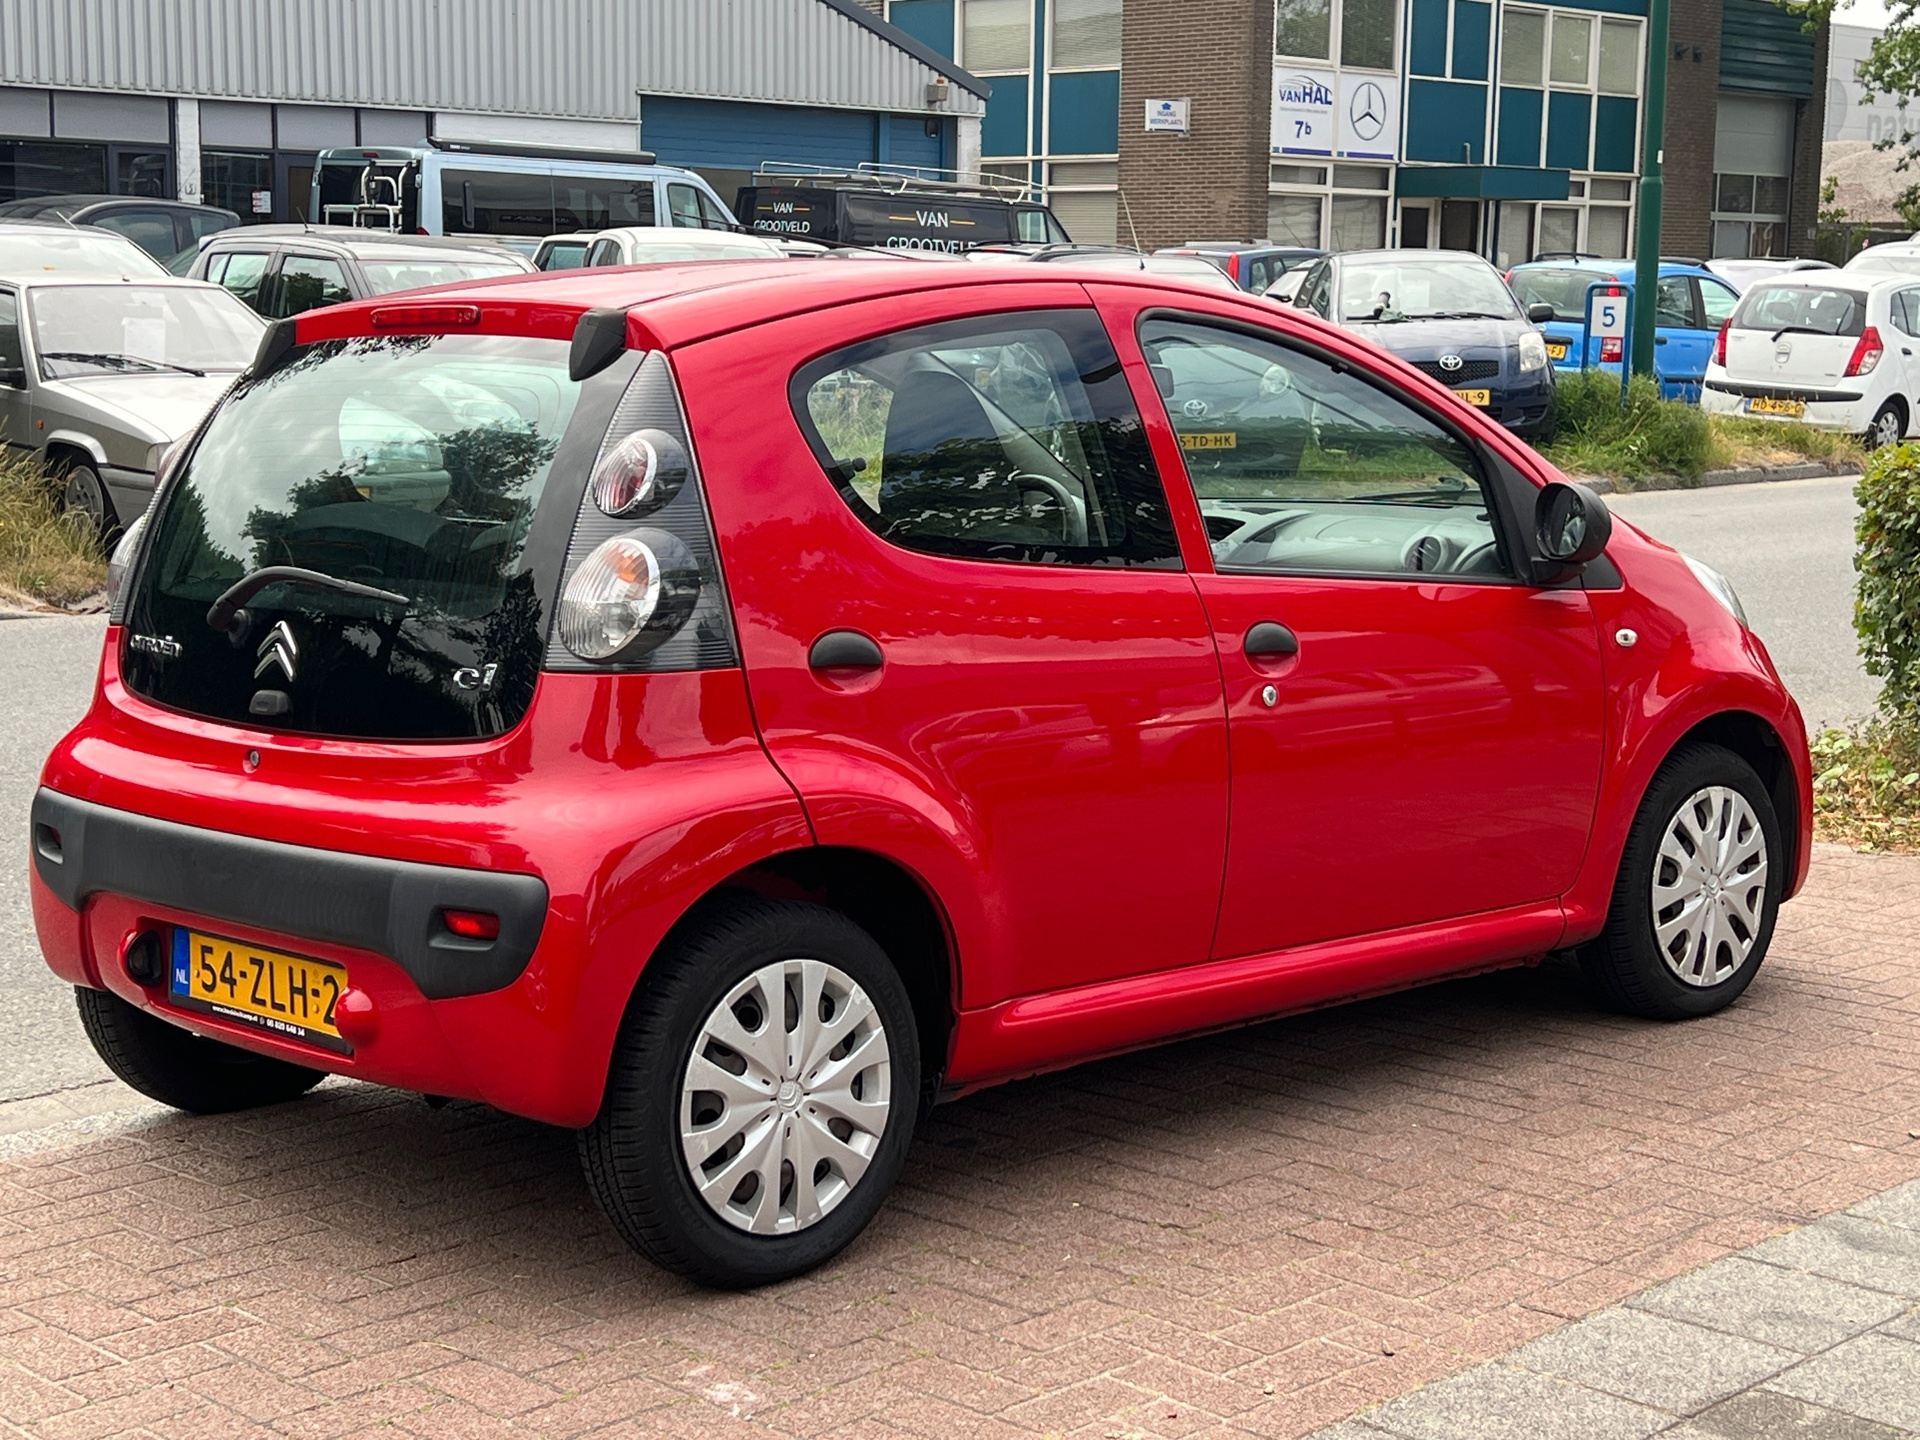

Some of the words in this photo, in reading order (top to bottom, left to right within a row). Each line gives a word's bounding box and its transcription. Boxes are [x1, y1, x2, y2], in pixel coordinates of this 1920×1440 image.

[773, 202, 794, 214] VAN
[753, 219, 811, 234] GROOTVELD
[915, 210, 949, 228] VAN
[1602, 305, 1616, 328] 5
[175, 968, 189, 985] NL
[200, 945, 338, 1026] 54-ZLH-2
